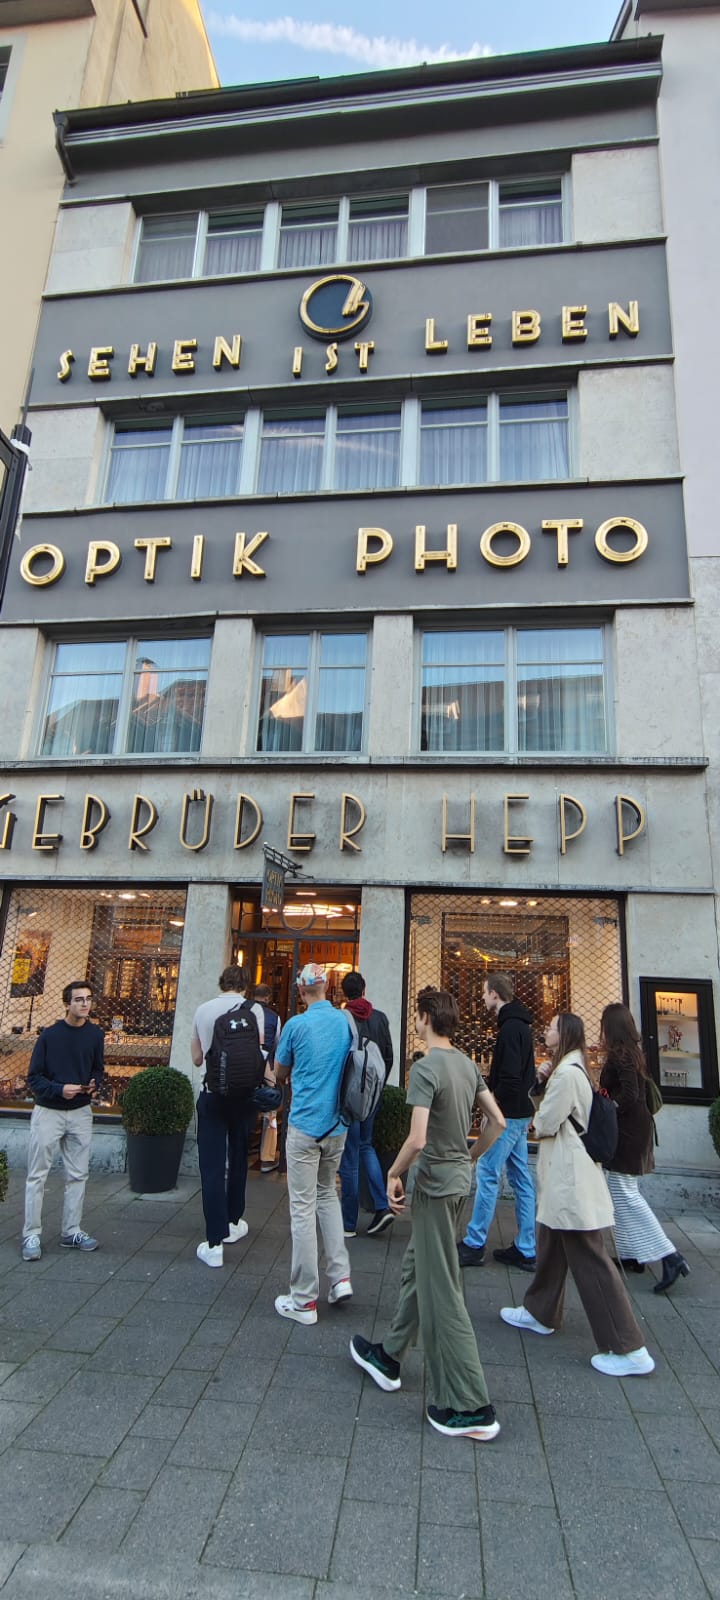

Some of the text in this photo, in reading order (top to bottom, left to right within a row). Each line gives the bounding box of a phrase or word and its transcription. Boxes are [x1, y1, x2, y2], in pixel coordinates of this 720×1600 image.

[57, 300, 640, 382] SEHEN IST LEBEN
[20, 516, 649, 588] OPTIK PHOTO
[442, 793, 646, 856] HEPP
